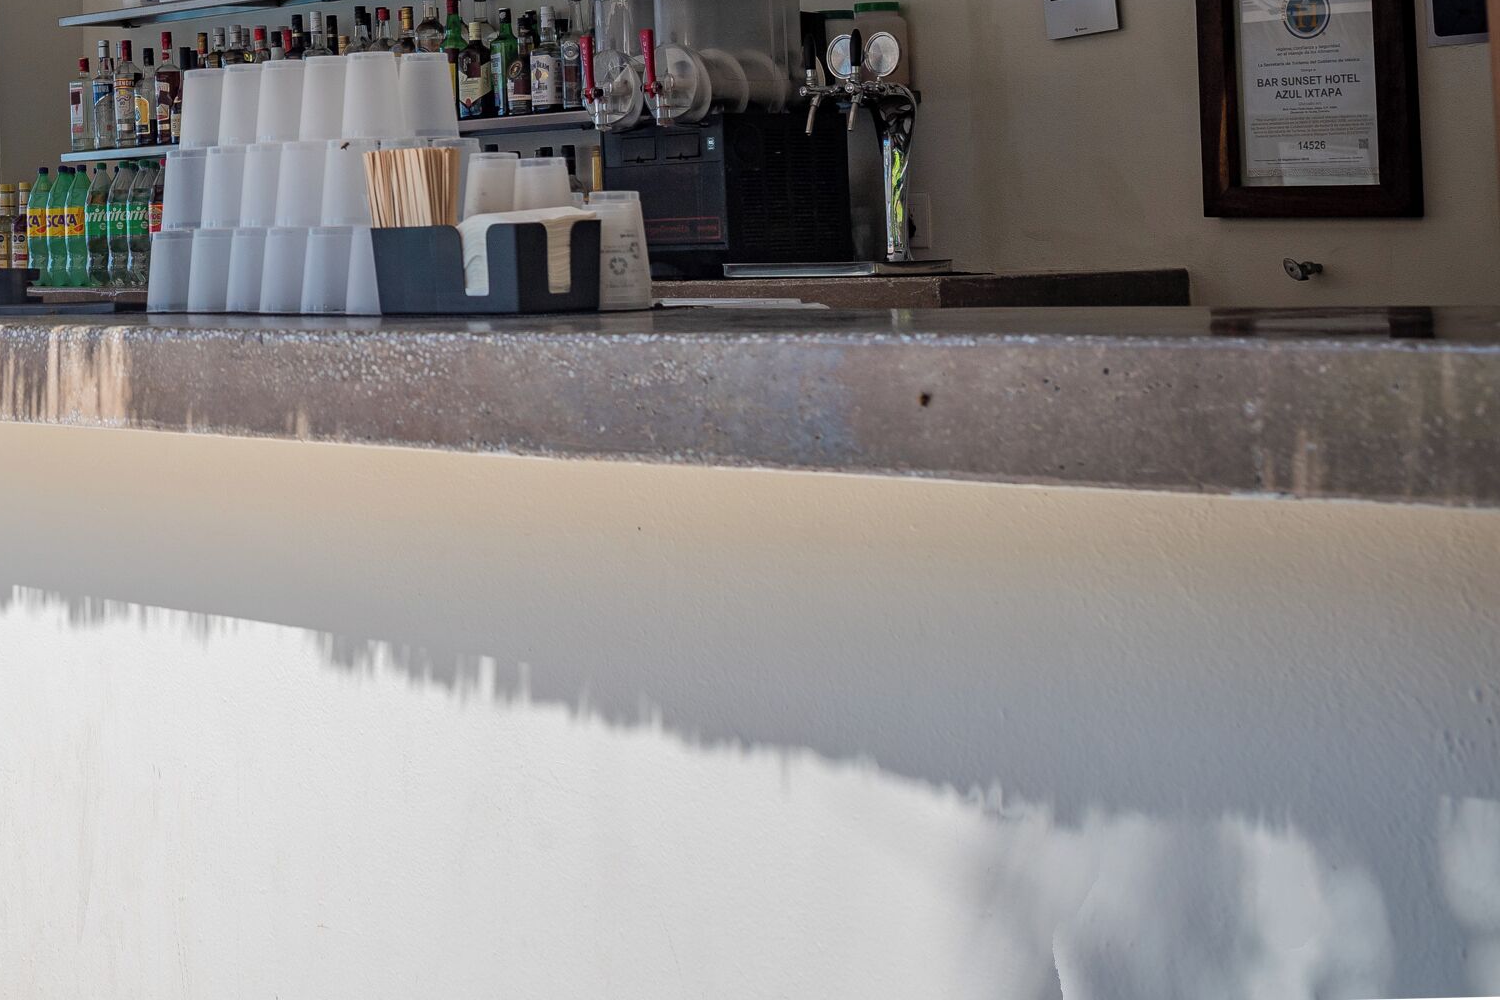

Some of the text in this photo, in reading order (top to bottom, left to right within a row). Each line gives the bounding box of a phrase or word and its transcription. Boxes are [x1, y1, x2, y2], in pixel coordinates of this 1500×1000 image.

[1257, 74, 1360, 88] BAR SUNSET HOTEL
[1275, 88, 1342, 100] AZUL IXTAPA
[1298, 140, 1326, 150] 14526
